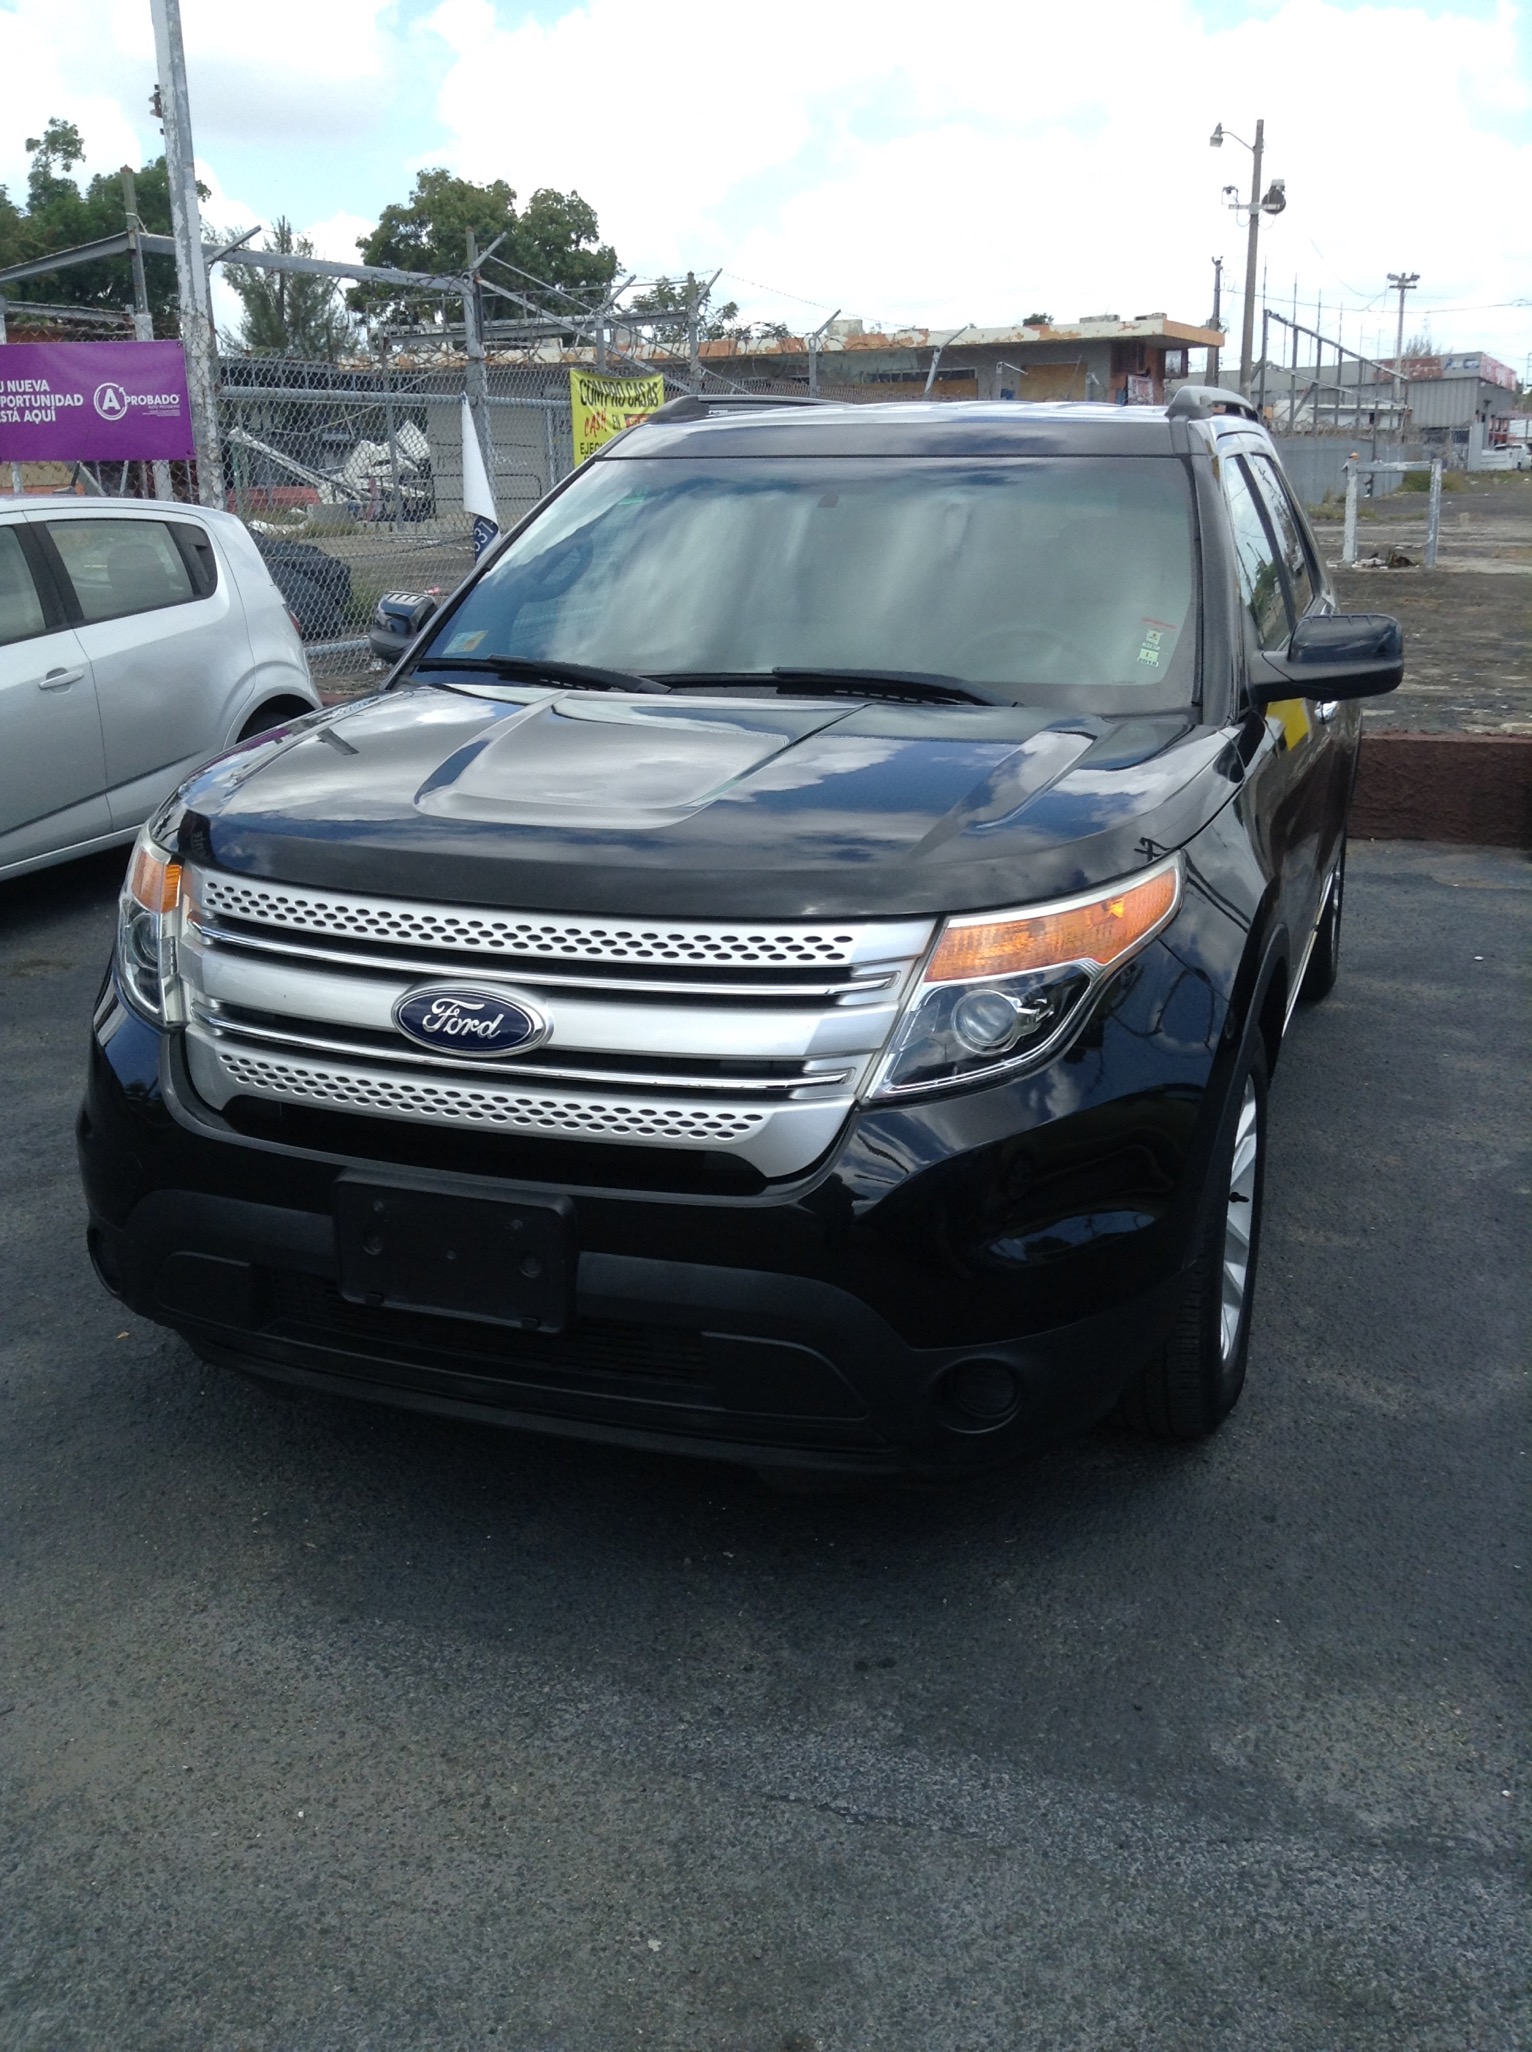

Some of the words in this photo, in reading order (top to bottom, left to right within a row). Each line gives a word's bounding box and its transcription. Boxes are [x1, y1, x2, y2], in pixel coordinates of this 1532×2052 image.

[7, 379, 50, 392] NUEVA
[580, 379, 625, 406] COMPRO
[626, 381, 659, 408] CASAS
[0, 393, 84, 408] PORTUNIDAD
[0, 407, 21, 422] STÁ
[24, 406, 56, 424] AQUÍ
[584, 408, 607, 438] CASH
[580, 442, 605, 455] EJEC
[422, 998, 505, 1040] Ford
